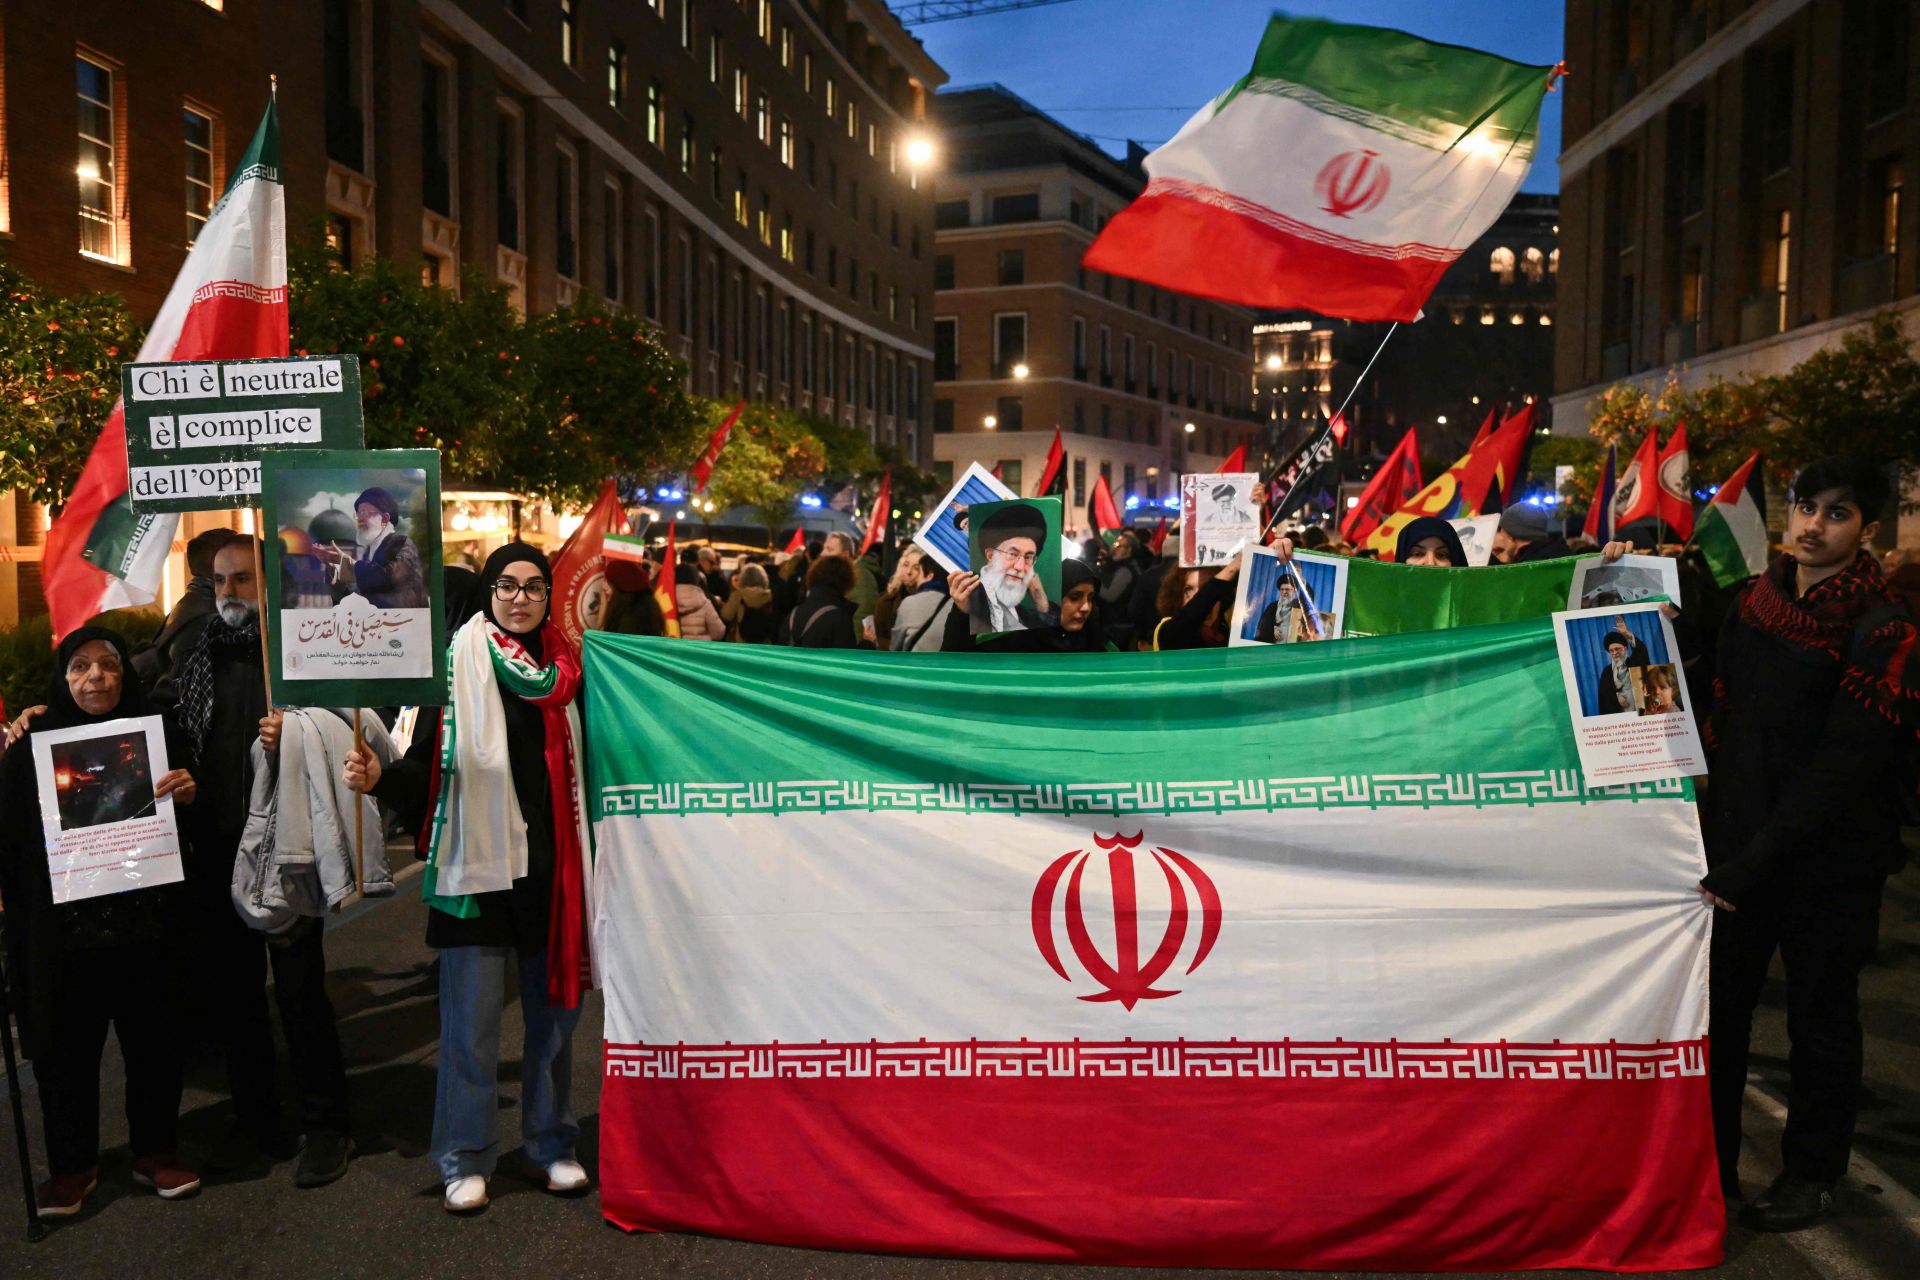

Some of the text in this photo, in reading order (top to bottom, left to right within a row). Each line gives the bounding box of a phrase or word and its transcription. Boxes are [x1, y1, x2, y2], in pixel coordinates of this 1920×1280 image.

[139, 364, 340, 395] Chi è neutrale
[156, 411, 312, 446] è complice
